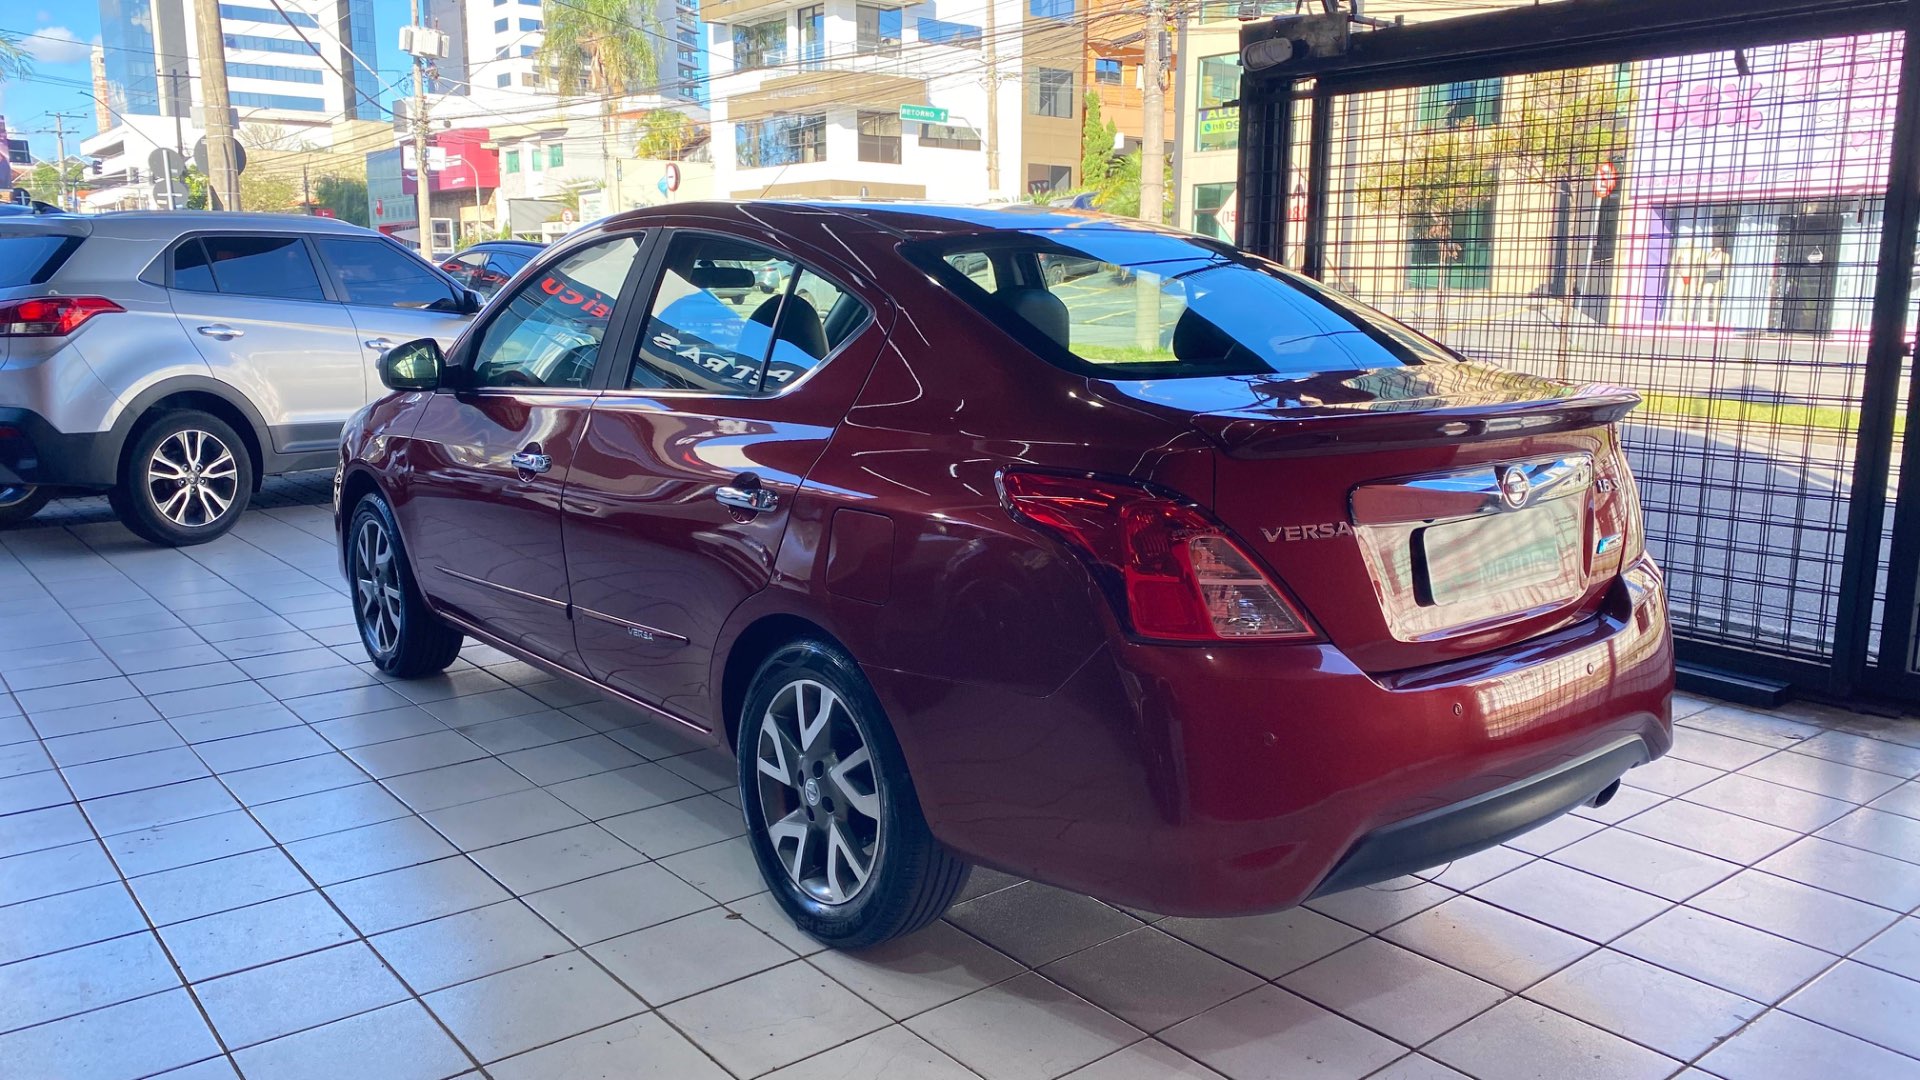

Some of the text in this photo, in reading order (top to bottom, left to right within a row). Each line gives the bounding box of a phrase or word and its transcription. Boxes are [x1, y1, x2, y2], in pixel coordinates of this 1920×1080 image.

[901, 108, 935, 118] RETORNO
[1260, 521, 1353, 542] VERSA
[627, 626, 654, 641] VERSA
